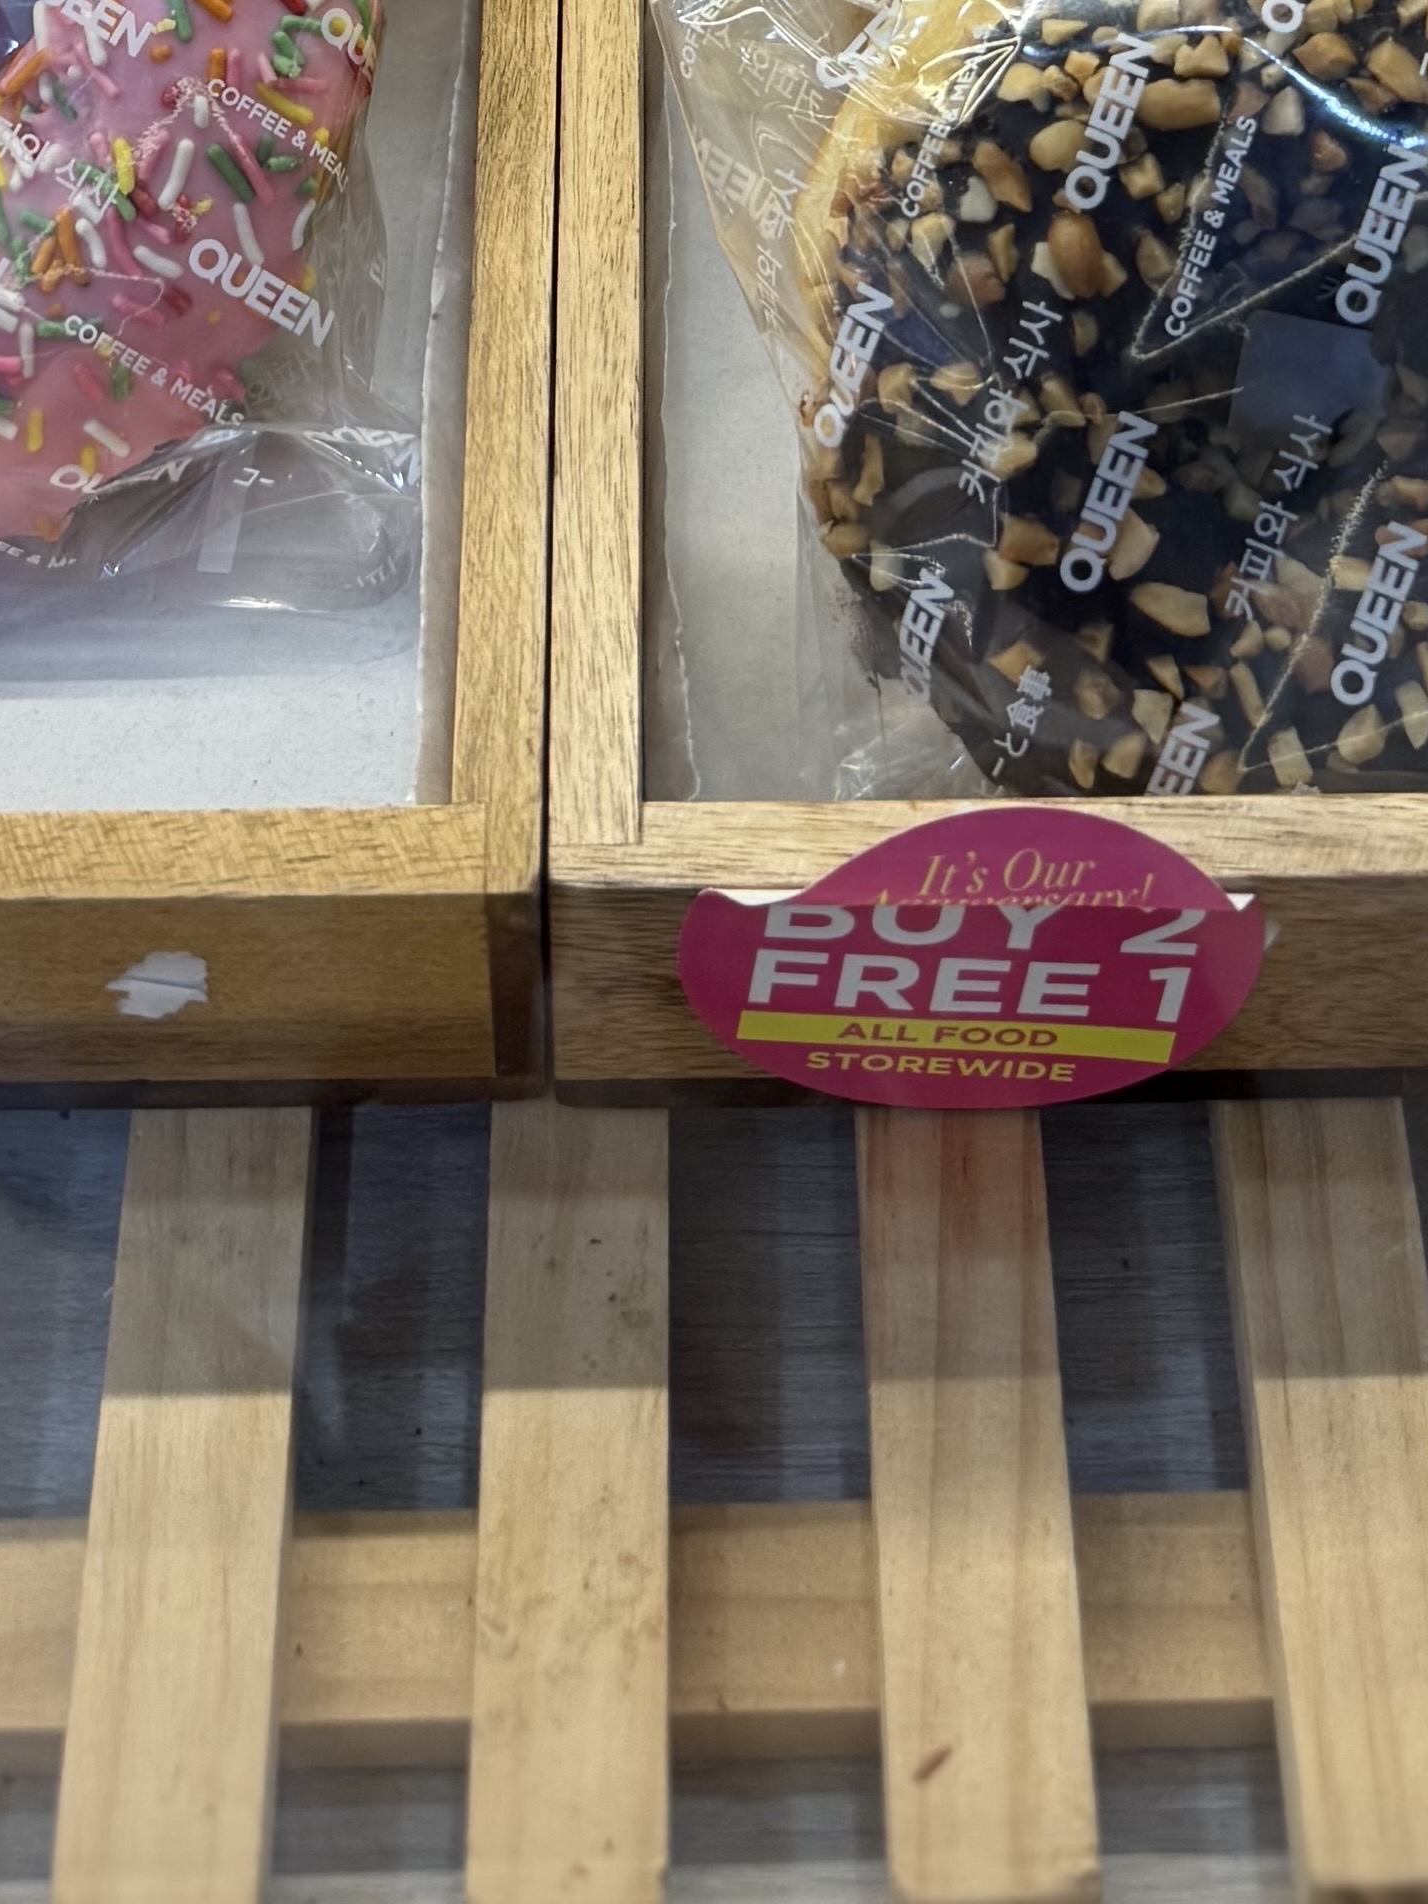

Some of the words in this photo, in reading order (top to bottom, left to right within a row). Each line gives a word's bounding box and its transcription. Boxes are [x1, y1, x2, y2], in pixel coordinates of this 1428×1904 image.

[207, 78, 287, 140] COFFEE
[292, 130, 307, 148] &
[1066, 32, 1155, 211] QUEEN
[1210, 114, 1258, 203] MEALS
[54, 158, 120, 224] 식사
[901, 121, 950, 219] COFFEE
[1201, 207, 1226, 227] &
[1166, 230, 1218, 340] COFFEE
[1335, 142, 1428, 325] QUEEN
[189, 238, 334, 348] QUEEN
[65, 314, 152, 378] COFFEE
[151, 368, 168, 387] &
[170, 377, 244, 426] MEALS
[813, 281, 895, 449] QUEEN
[958, 387, 1030, 503] 커피와
[1003, 296, 1063, 380] 식사
[1060, 410, 1158, 591] QUEEN
[1225, 501, 1301, 621] 커피와
[1273, 414, 1332, 491] 식사
[1331, 521, 1427, 707] QUEEN
[919, 850, 989, 895] It's
[1003, 847, 1096, 892] Our
[763, 905, 1061, 949] BUY
[1119, 908, 1206, 956] 2
[746, 948, 1101, 1017] FREE
[1149, 966, 1192, 1023] 1
[837, 1021, 918, 1043] ALL
[933, 1024, 1058, 1048] FOOD
[805, 1051, 1077, 1083] STOREWIDE
